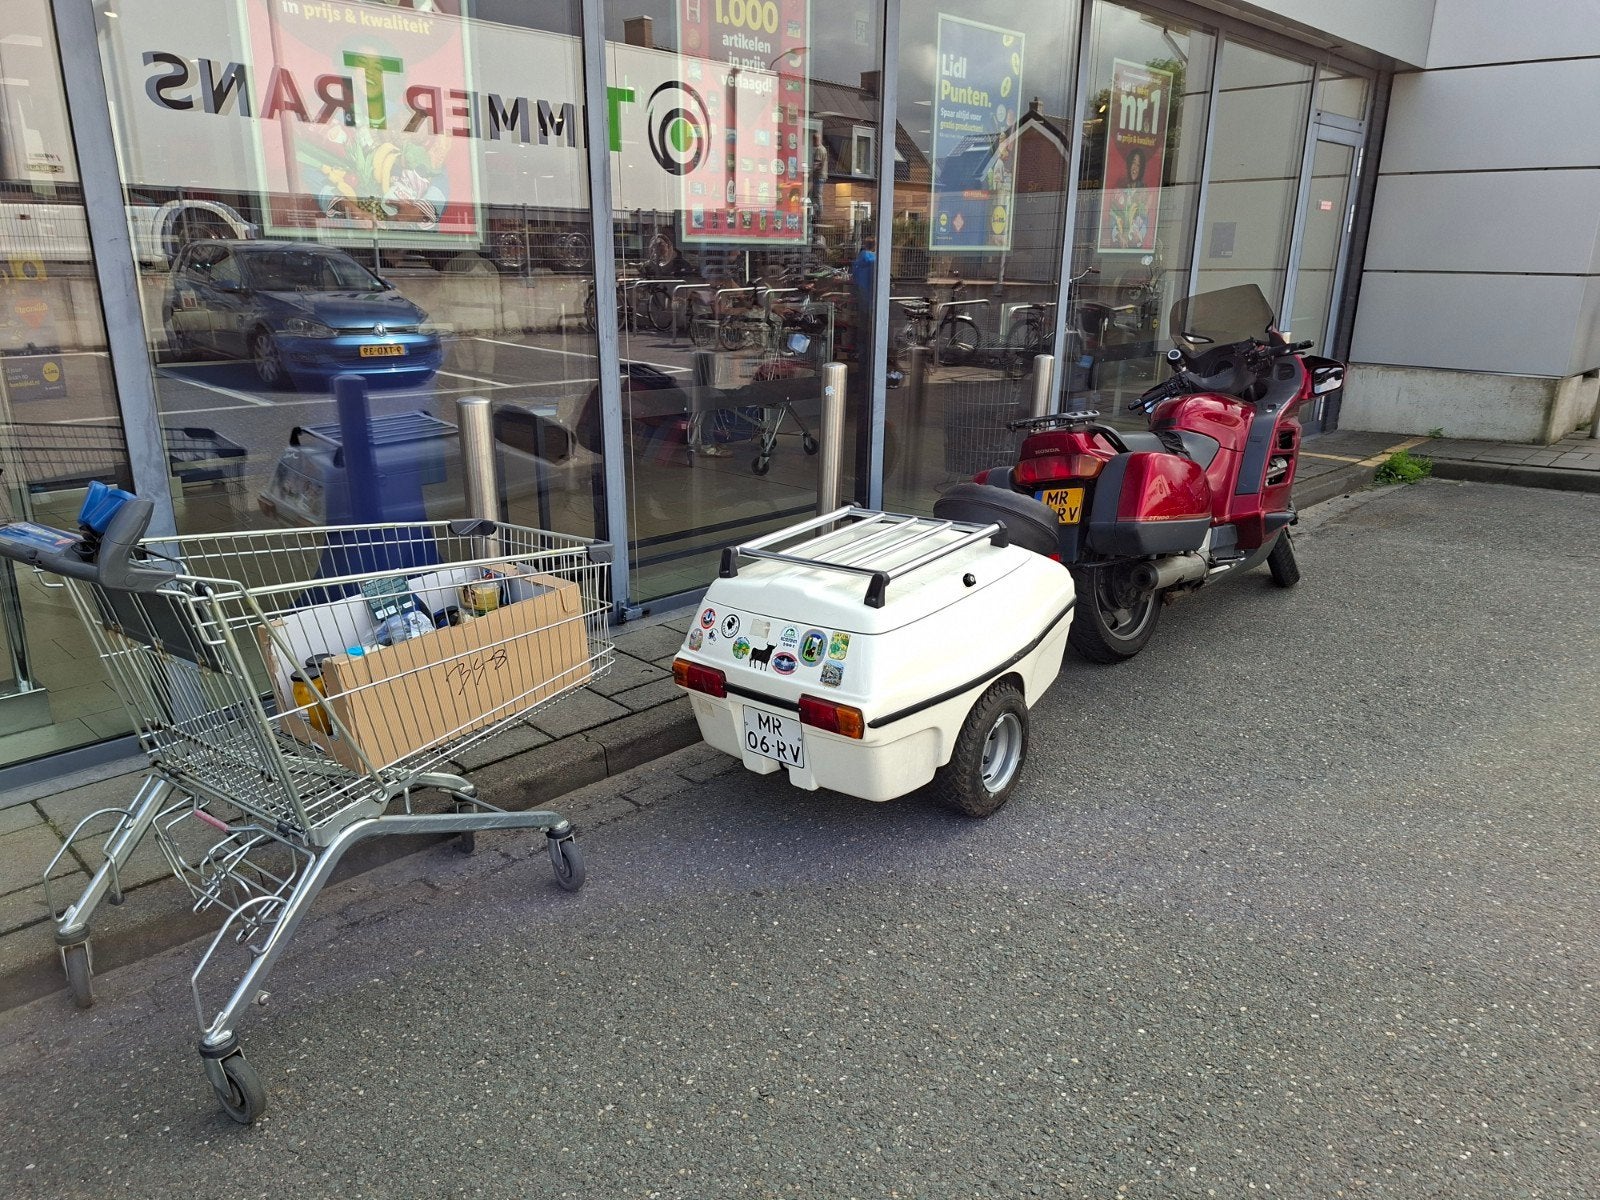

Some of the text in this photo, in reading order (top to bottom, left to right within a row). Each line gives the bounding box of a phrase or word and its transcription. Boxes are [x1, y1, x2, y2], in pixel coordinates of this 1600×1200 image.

[303, 3, 342, 23] prijs
[345, 8, 357, 24] &
[715, 0, 779, 34] 1.000
[722, 32, 771, 54] artikelen
[728, 51, 766, 75] in prijs
[942, 54, 967, 79] Lidl
[721, 74, 773, 95] verlaagd!
[941, 79, 992, 108] Punten.
[940, 107, 956, 118] Spaar
[1046, 491, 1069, 505] MR
[758, 713, 782, 737] MR
